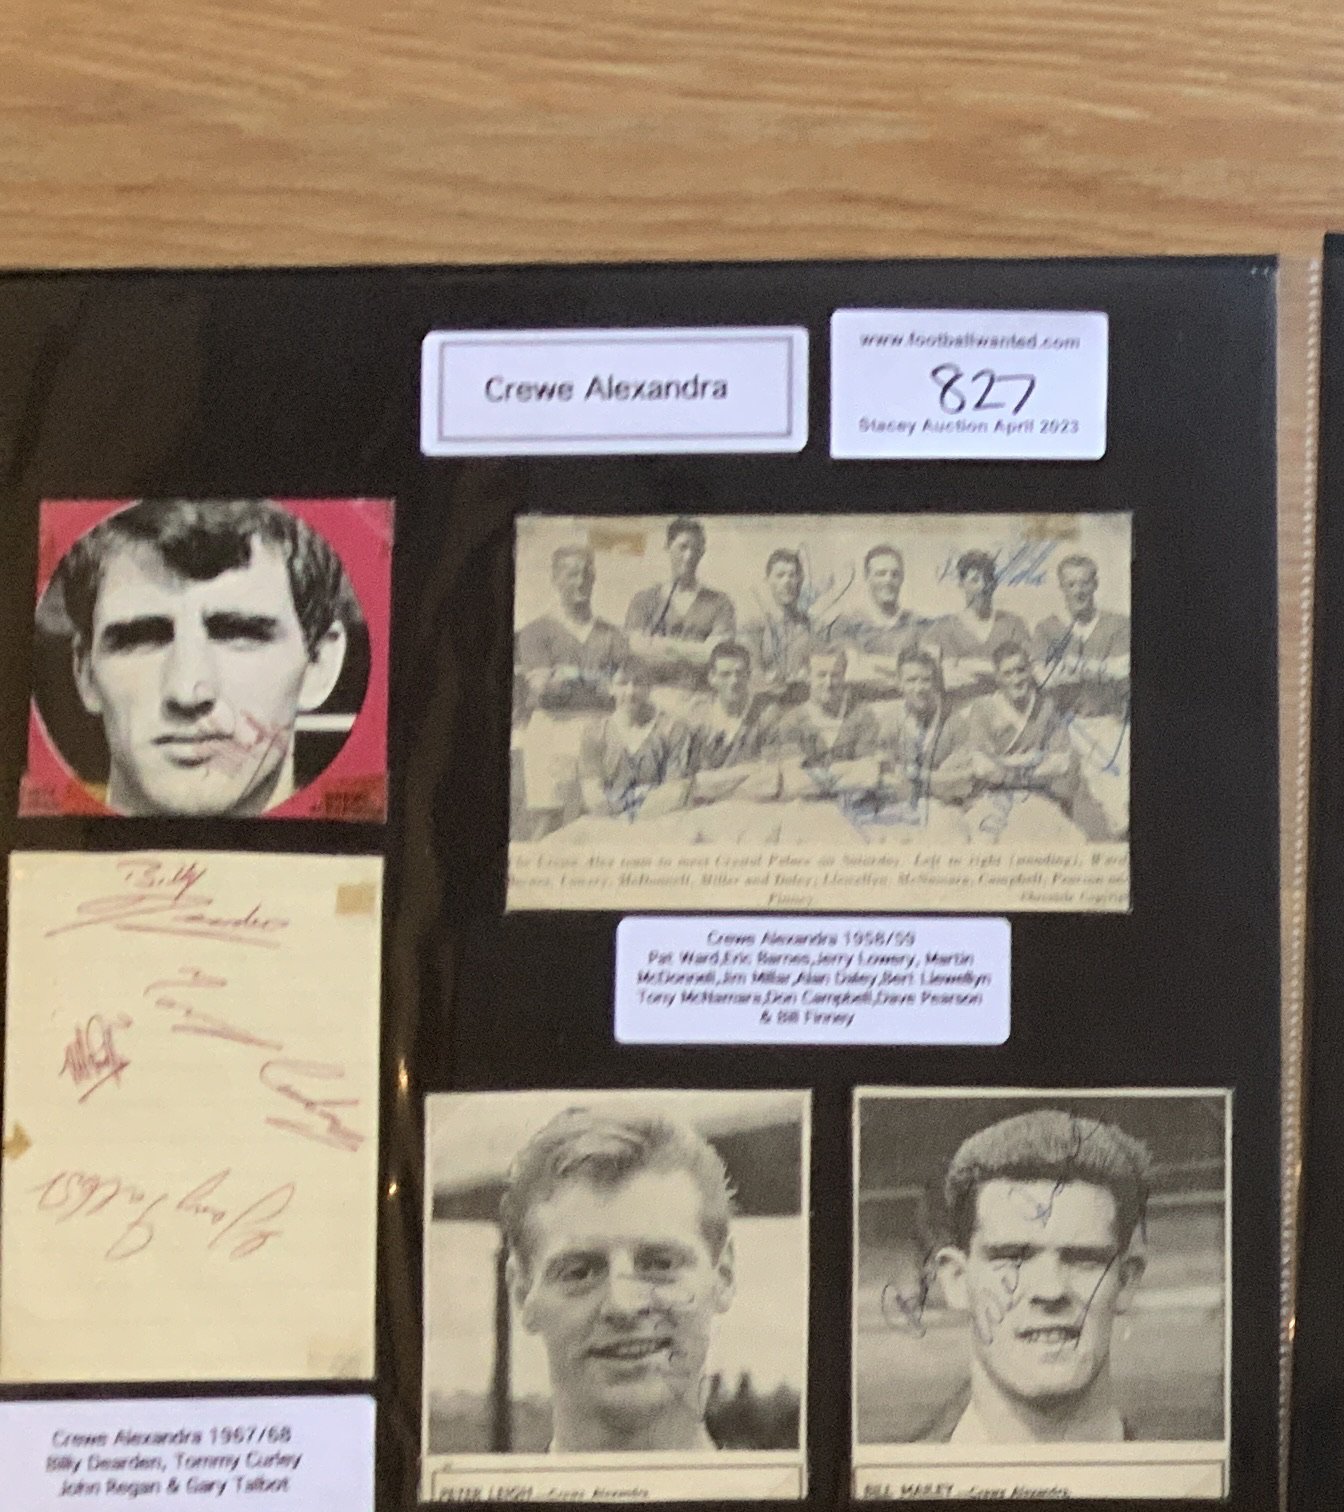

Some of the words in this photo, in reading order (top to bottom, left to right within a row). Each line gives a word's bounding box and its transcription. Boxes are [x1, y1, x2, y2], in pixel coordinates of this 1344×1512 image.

[859, 330, 1081, 350] www.footballwanted.com
[485, 374, 574, 403] Crewe
[585, 373, 728, 401] Alexandra
[930, 362, 1036, 416] 827
[858, 417, 916, 436] Stacey
[922, 418, 988, 434] Auction
[994, 418, 1034, 436] April
[1040, 418, 1080, 434] 2023
[707, 930, 756, 946] Crewe
[760, 930, 838, 947] Alexandra
[648, 950, 672, 965] Pat
[926, 950, 974, 966] Martin
[638, 989, 677, 1009] Tony
[51, 1427, 108, 1448] Crewe
[114, 1426, 203, 1447] Alexandra
[175, 1453, 241, 1474] Tommy
[58, 1478, 101, 1498] John
